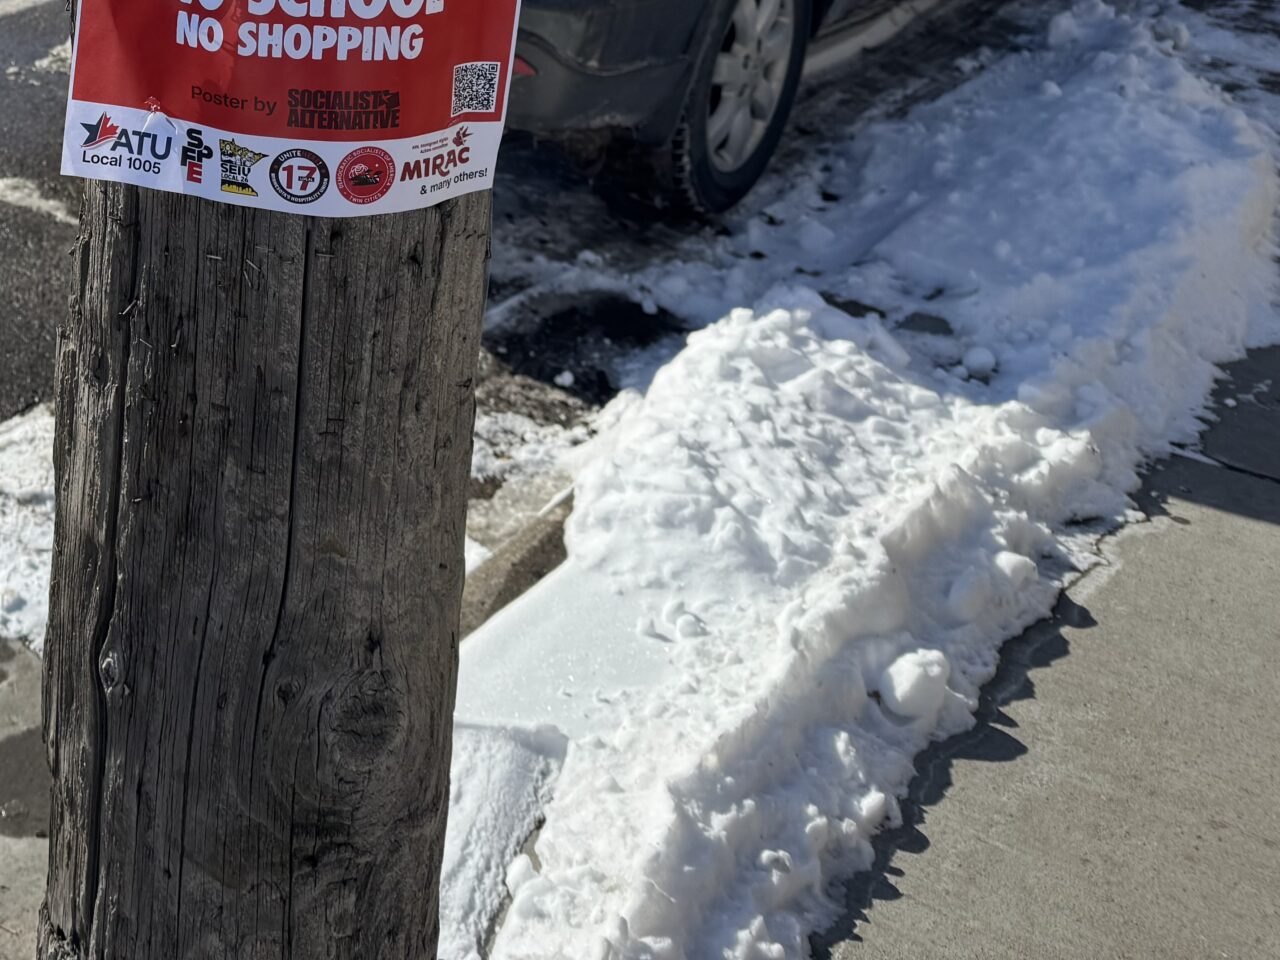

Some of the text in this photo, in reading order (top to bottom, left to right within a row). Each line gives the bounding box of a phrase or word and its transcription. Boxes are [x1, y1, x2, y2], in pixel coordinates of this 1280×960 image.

[176, 11, 424, 61] NO SHOPPING
[191, 86, 277, 116] Poster by
[287, 88, 387, 110] SOCIALIST
[286, 108, 400, 131] ALTERNATIVE
[110, 128, 173, 160] ATU
[82, 150, 161, 174] Local 1005
[220, 162, 251, 177] SEIU
[400, 147, 470, 182] MIRAC
[282, 164, 317, 191] 17
[420, 167, 488, 195] & many others!
